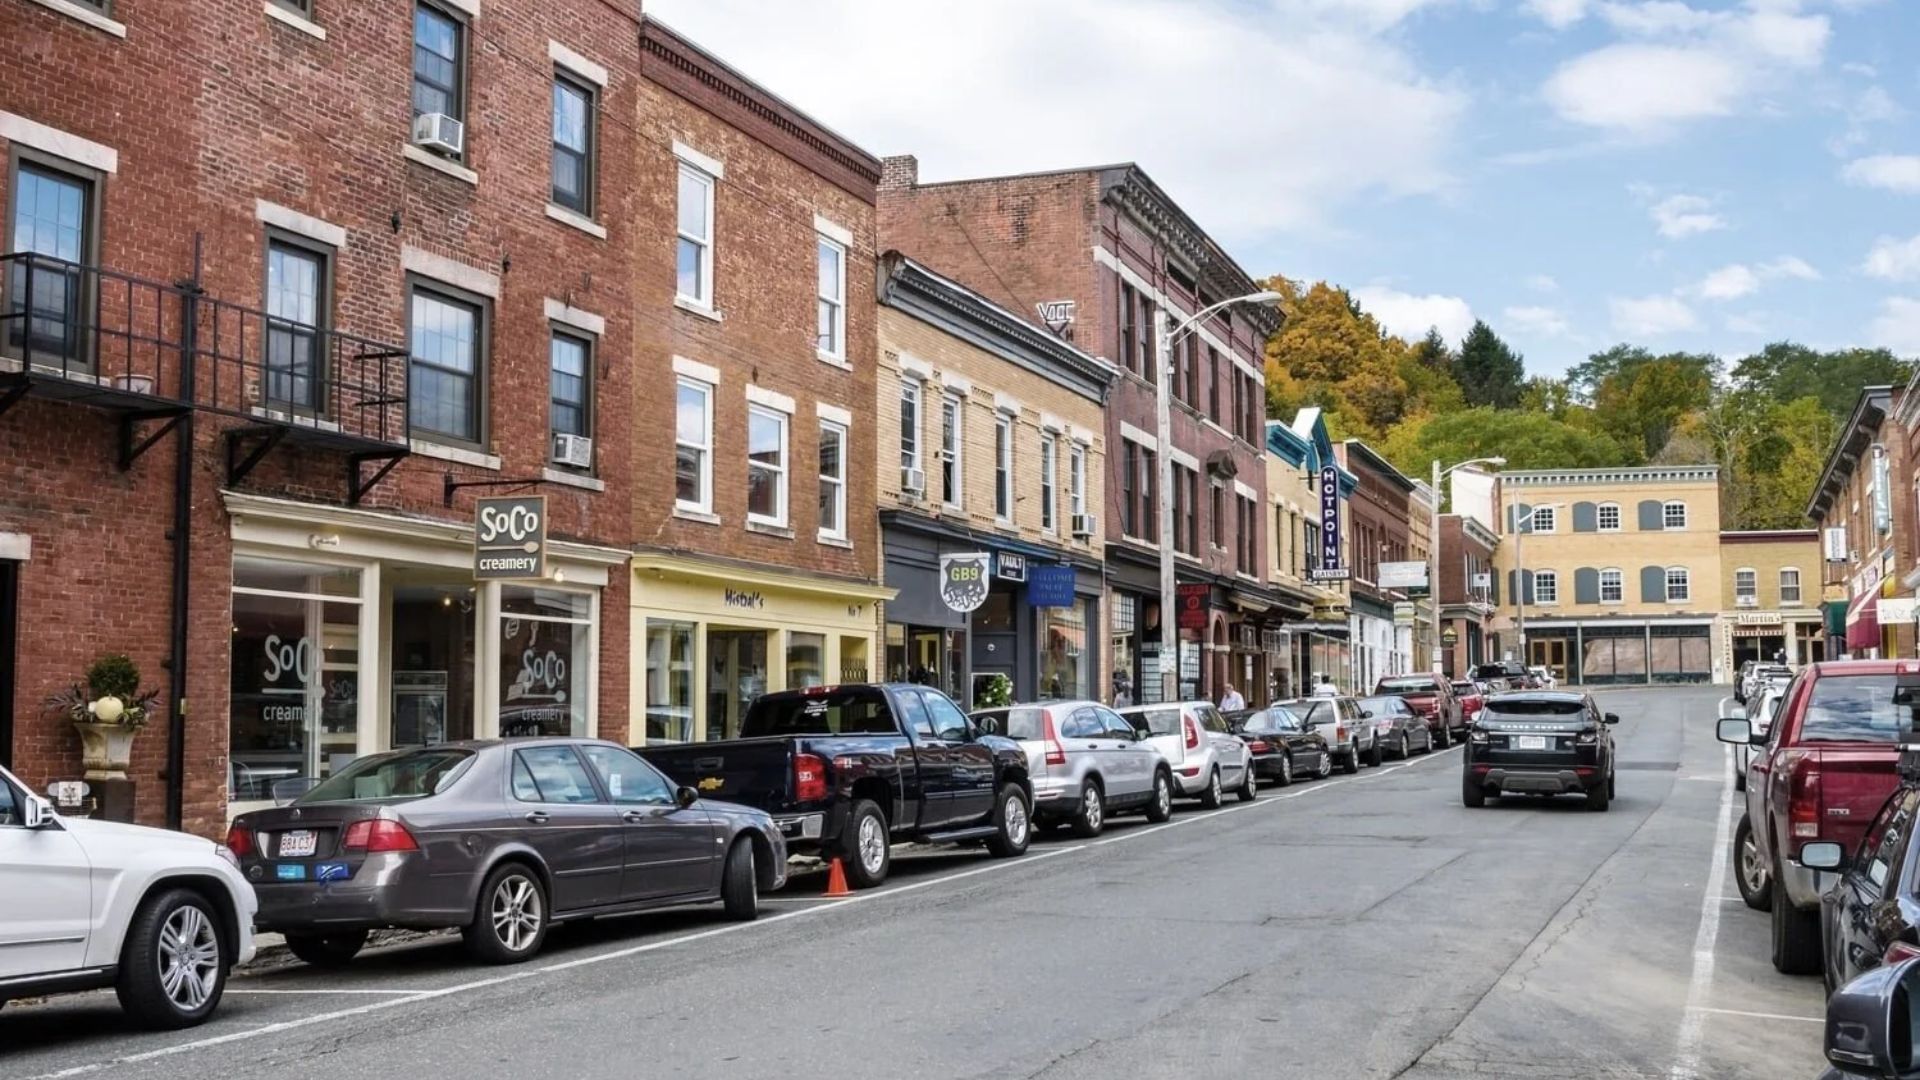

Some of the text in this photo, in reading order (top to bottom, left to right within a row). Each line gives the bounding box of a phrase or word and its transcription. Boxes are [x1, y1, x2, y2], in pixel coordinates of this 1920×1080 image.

[481, 505, 538, 541] SoCo
[1324, 470, 1336, 569] HOTPOINT
[480, 558, 536, 572] creamery
[1000, 554, 1022, 569] VAULT
[951, 567, 979, 581] GB9
[1741, 613, 1780, 623] Martin's
[522, 649, 565, 688] SoCo
[522, 708, 565, 724] creamery
